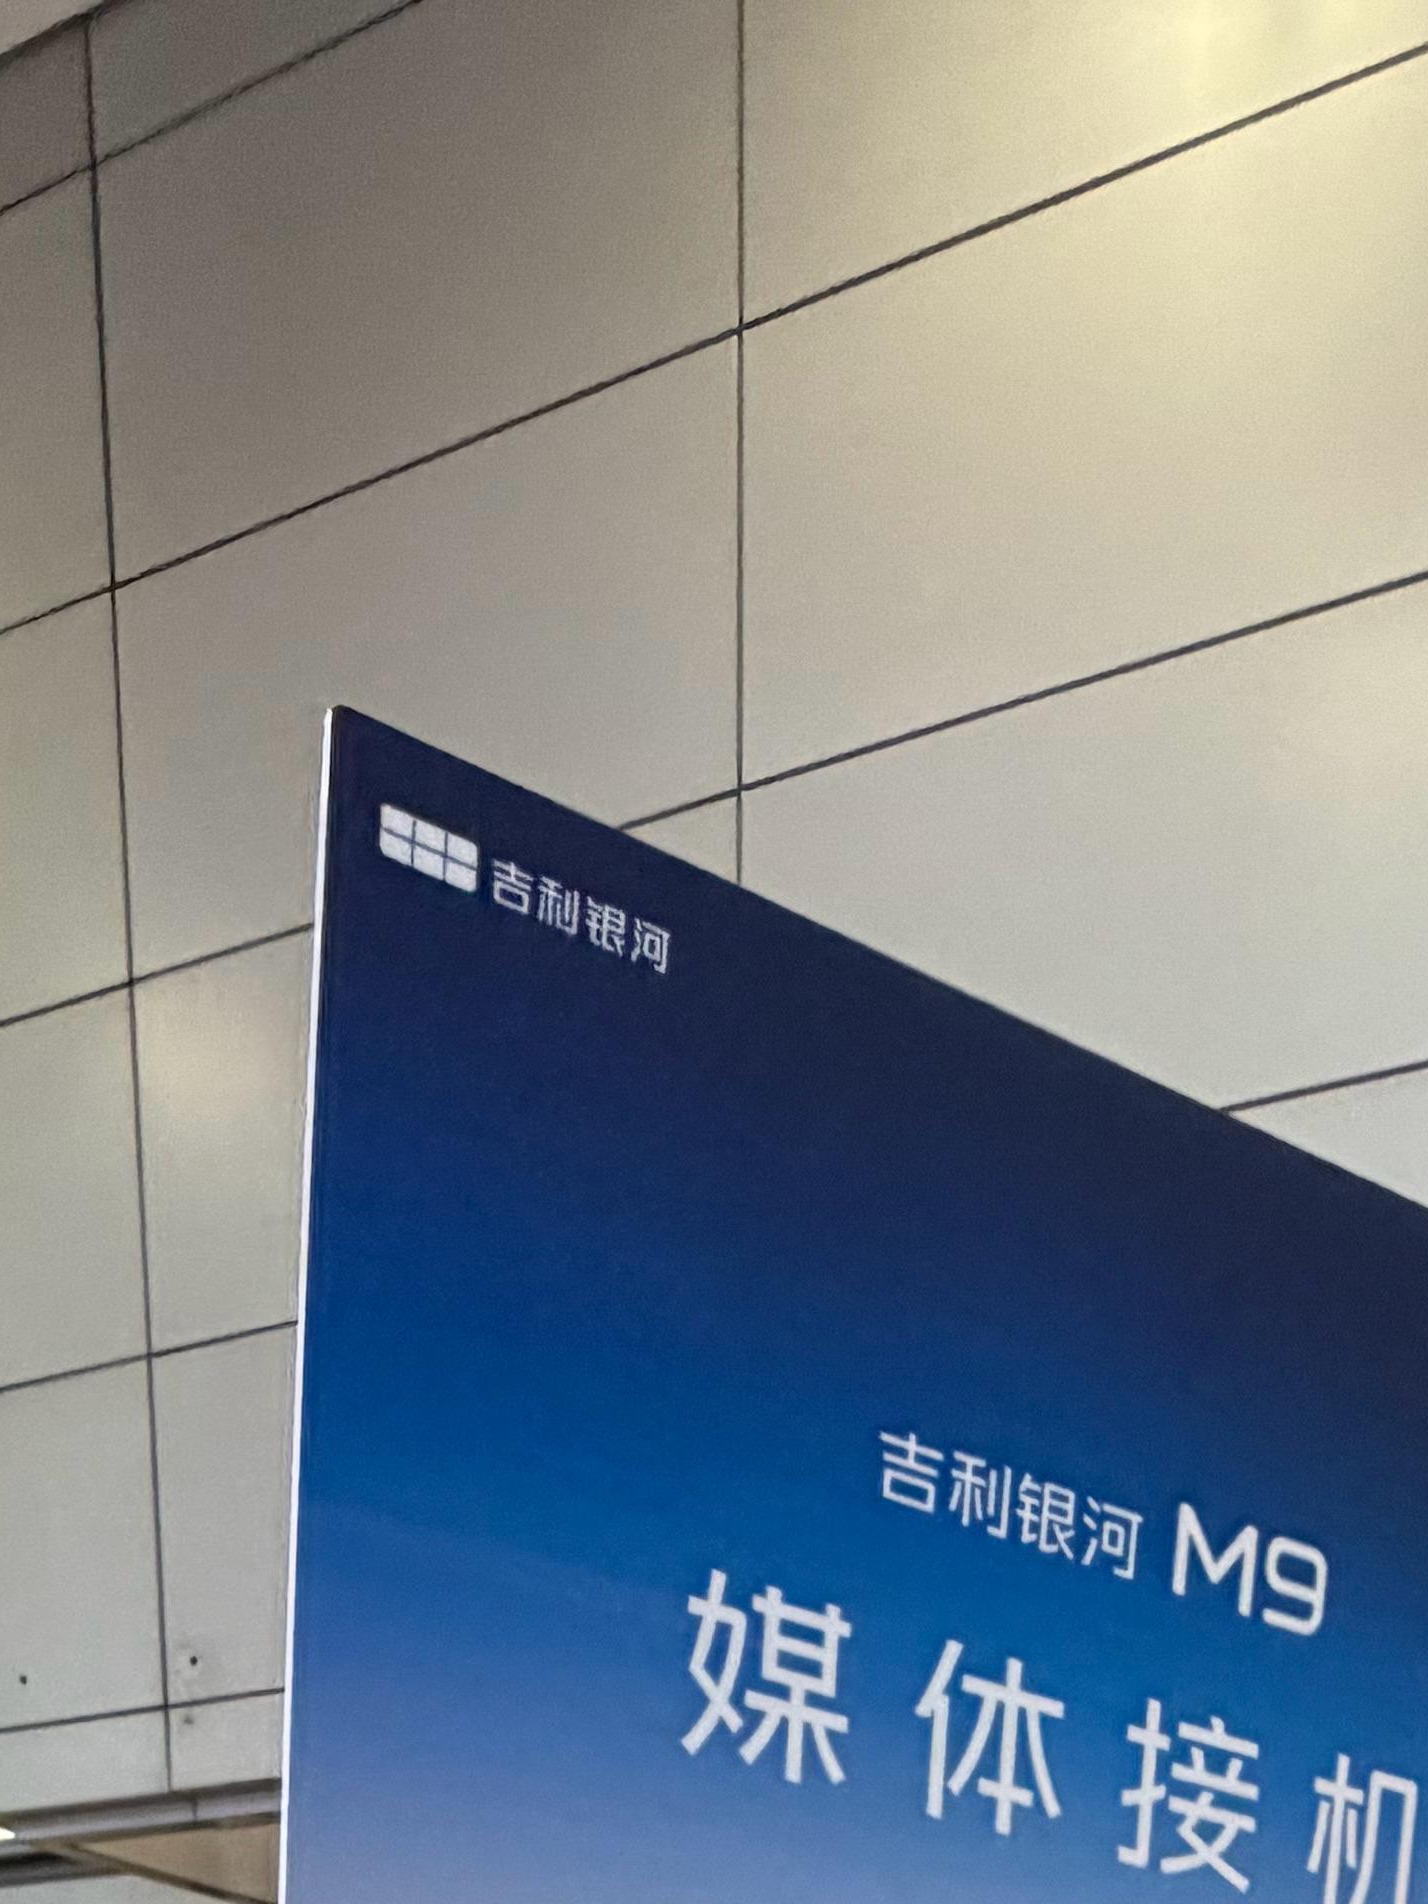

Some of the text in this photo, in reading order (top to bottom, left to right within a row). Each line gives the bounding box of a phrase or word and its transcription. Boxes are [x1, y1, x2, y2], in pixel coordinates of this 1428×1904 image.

[490, 857, 671, 976] 吉利银河
[879, 1431, 1329, 1637] 吉利银河 M9
